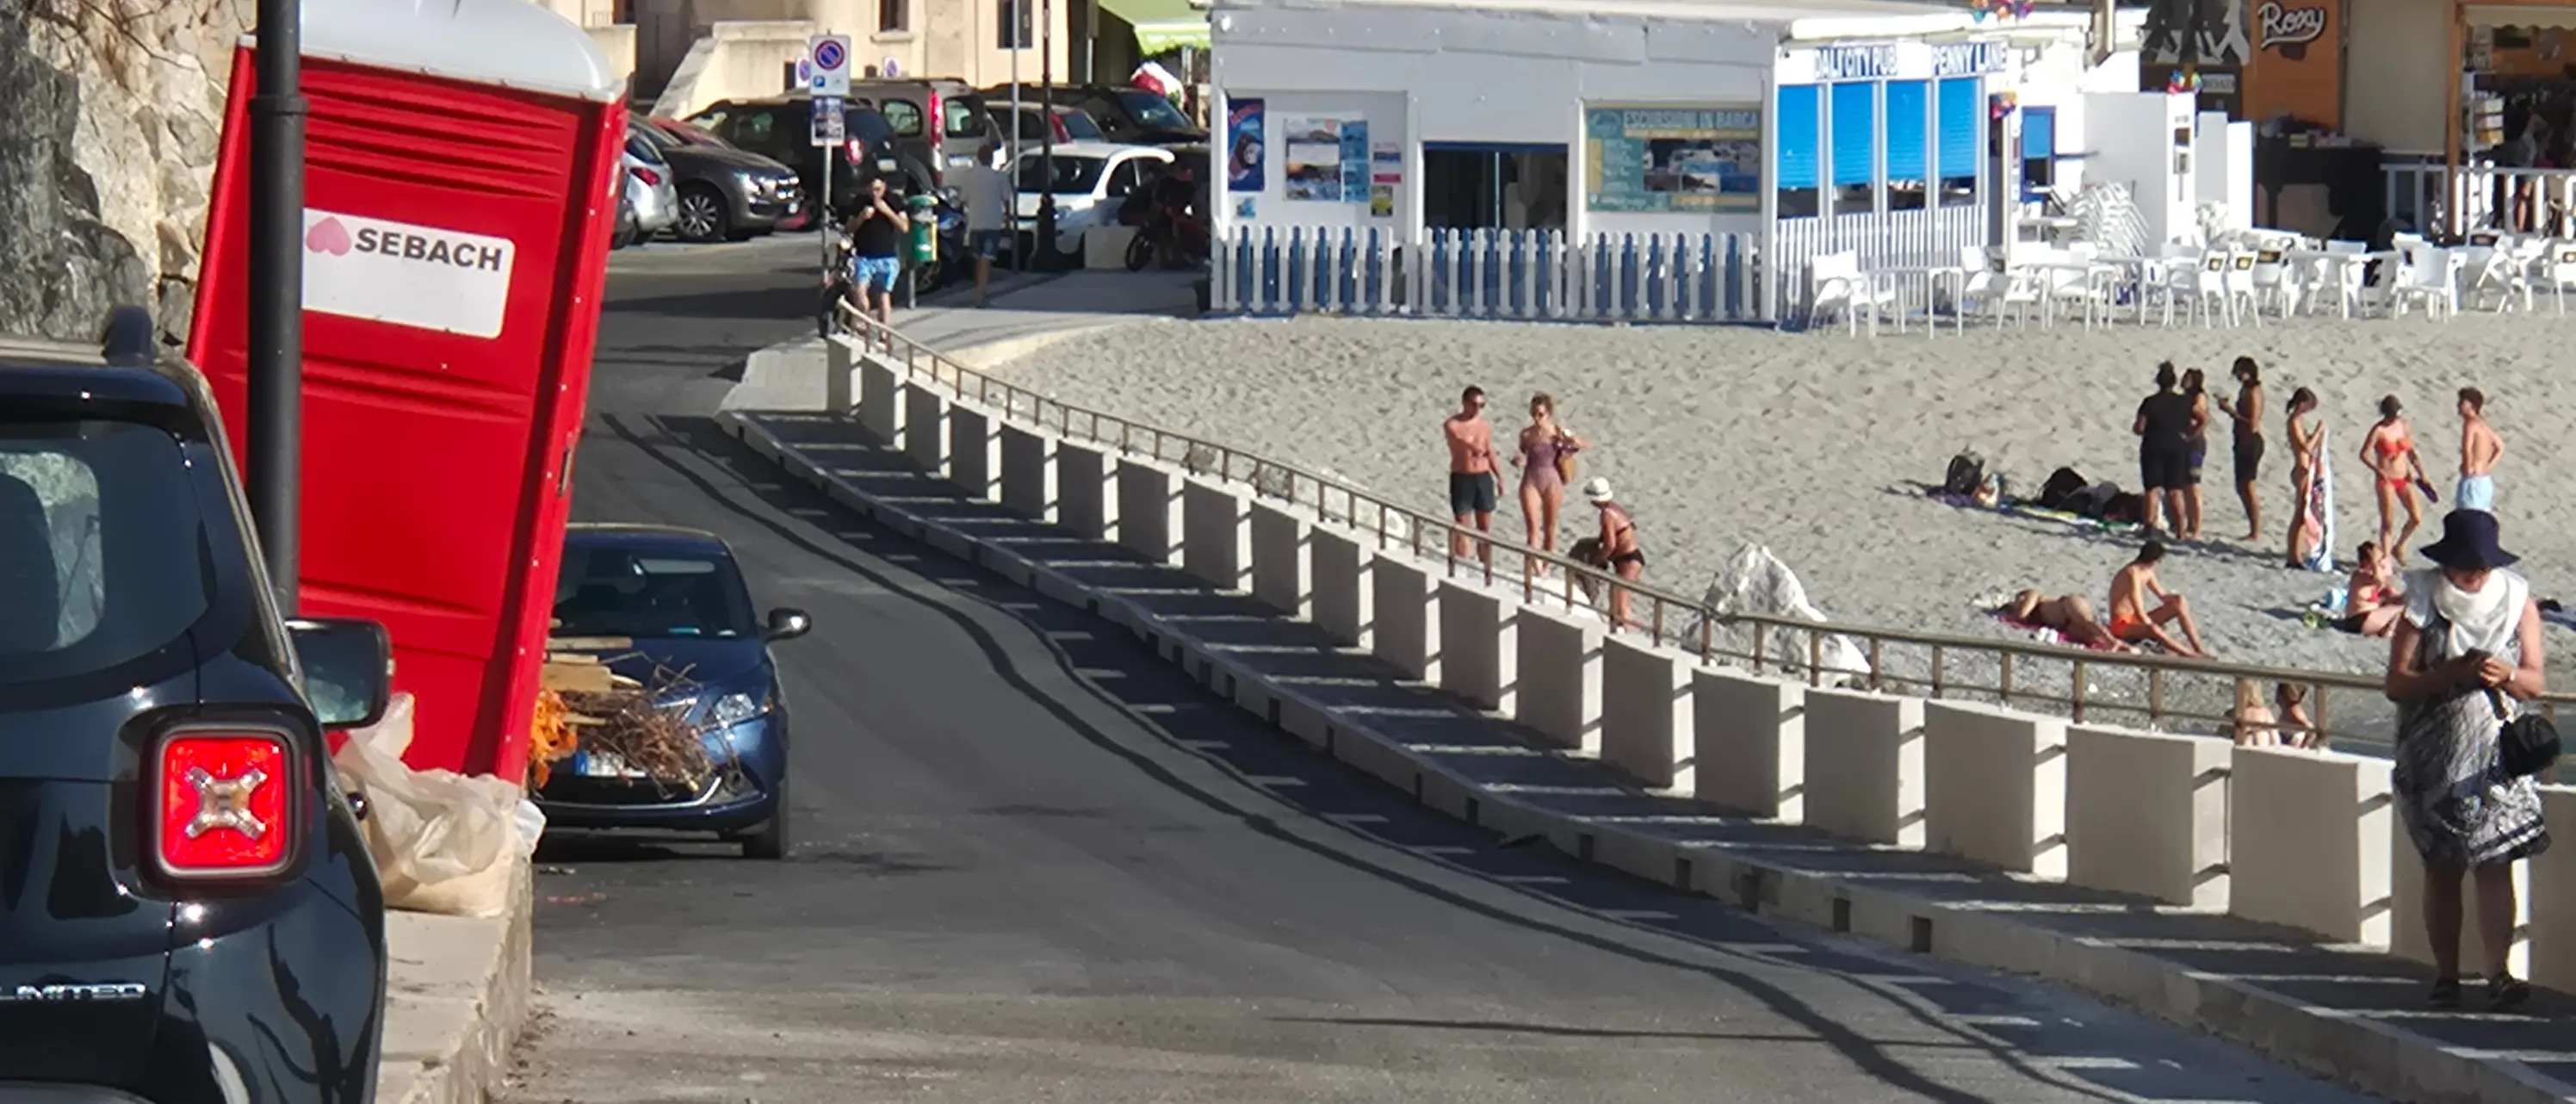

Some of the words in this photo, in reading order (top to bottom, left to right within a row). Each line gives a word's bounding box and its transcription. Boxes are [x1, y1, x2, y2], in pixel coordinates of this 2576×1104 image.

[1846, 47, 1872, 78] CITY
[1873, 46, 1898, 78] PUB
[1932, 44, 1974, 76] PENNY
[1977, 40, 2007, 72] LANE
[1700, 111, 1713, 128] IN
[1716, 111, 1758, 128] BARCA
[355, 227, 503, 272] SEBACH
